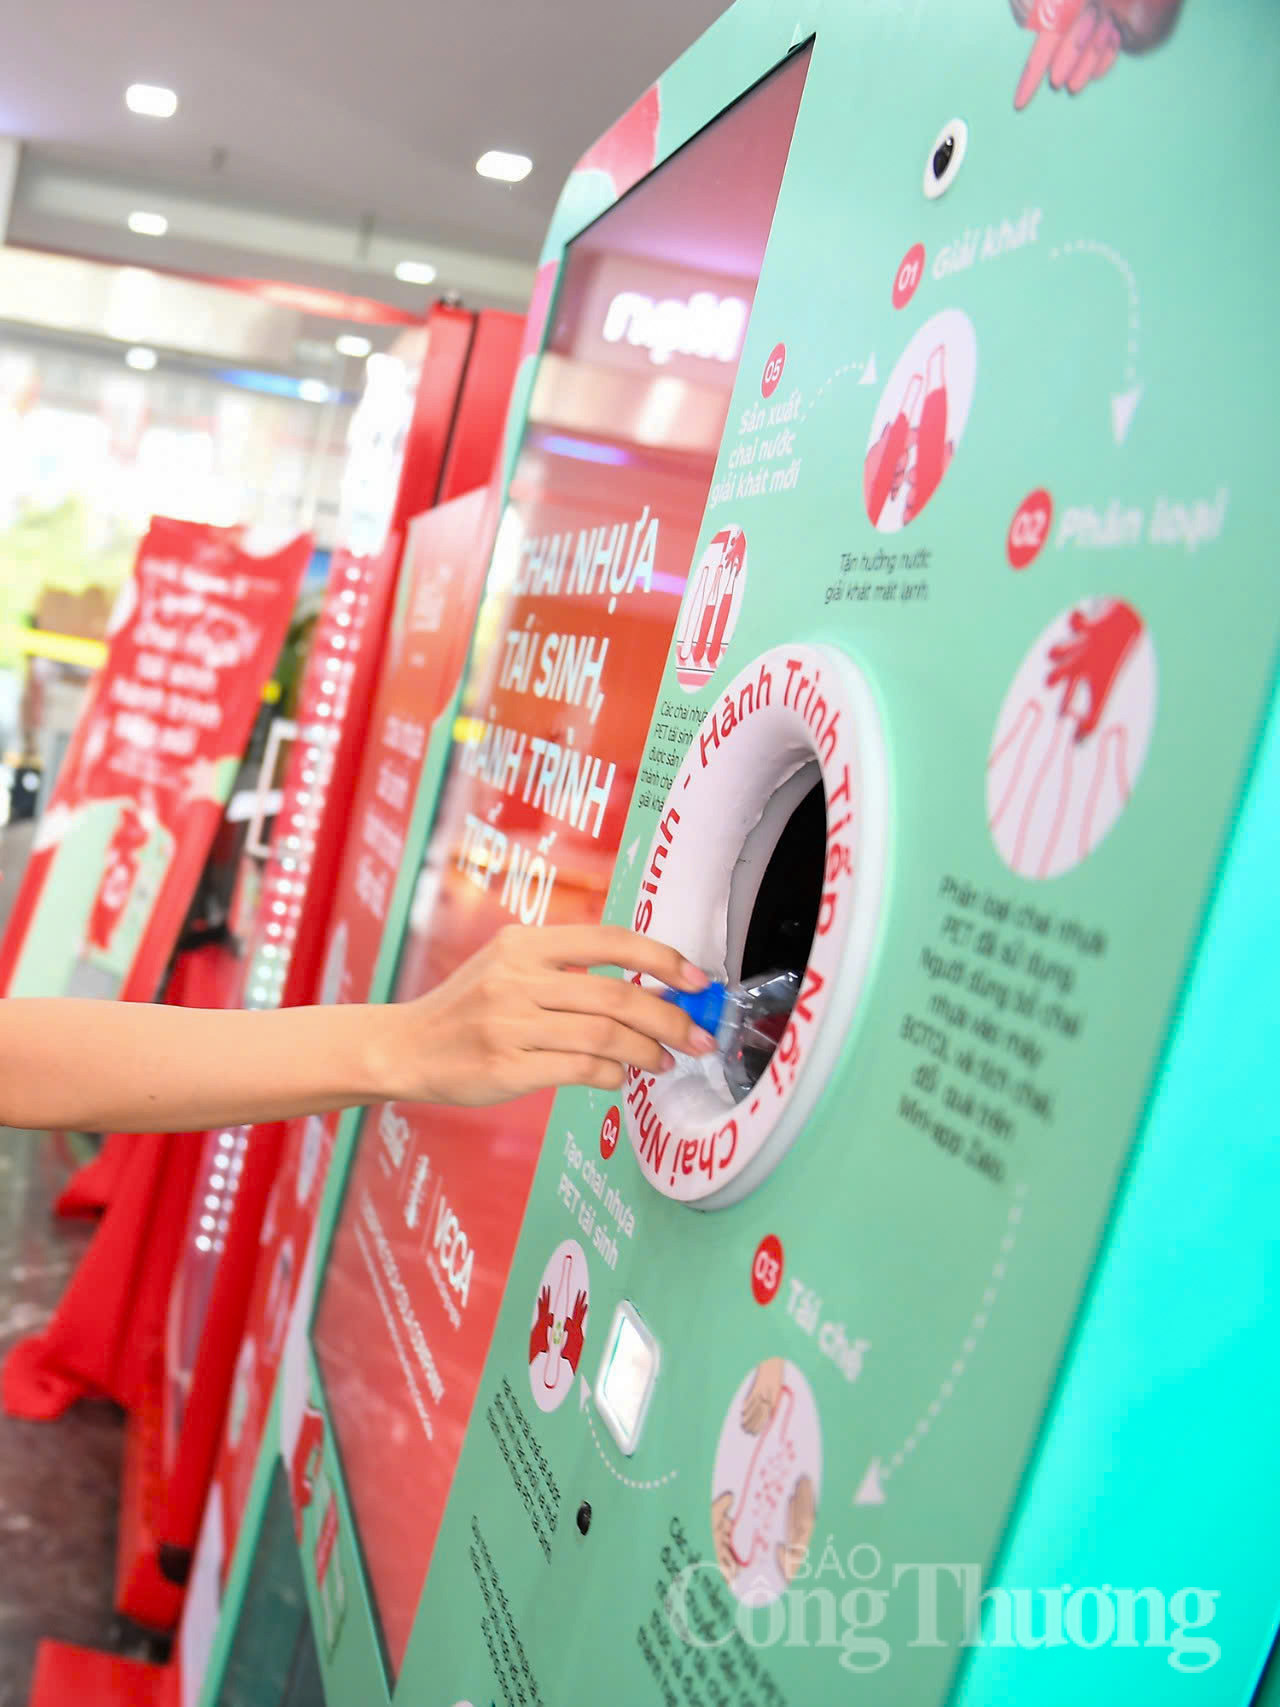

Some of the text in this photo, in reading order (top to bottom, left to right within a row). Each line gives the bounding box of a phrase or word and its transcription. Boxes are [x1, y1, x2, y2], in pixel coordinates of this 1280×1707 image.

[898, 262, 919, 291] 01
[764, 359, 781, 383] 05
[728, 437, 756, 468] chai
[710, 471, 735, 509] giải
[735, 466, 768, 498] khát
[575, 505, 659, 615] NHỰA
[1011, 510, 1048, 548] 02
[499, 612, 541, 695] TÁI
[655, 722, 694, 745] PET tái sinh
[661, 700, 674, 718] Các
[674, 703, 689, 720] chai
[699, 664, 772, 768] Hành
[783, 659, 841, 768] Trình
[523, 727, 617, 840] TRÌNH
[640, 768, 659, 785] thành
[649, 746, 666, 766] được
[652, 795, 665, 812] khá
[457, 802, 509, 892] TIẾP
[500, 831, 558, 928] NỐI
[634, 808, 680, 934] Sinh
[816, 764, 853, 936] Tiếp
[771, 966, 824, 1096] Nối
[602, 1119, 618, 1147] 04
[670, 1119, 738, 1186] Chai
[563, 1130, 635, 1239] Tạo chai nhựa
[434, 1195, 475, 1308] VECA
[558, 1173, 619, 1271] PET tái sinh
[754, 1251, 779, 1289] 03
